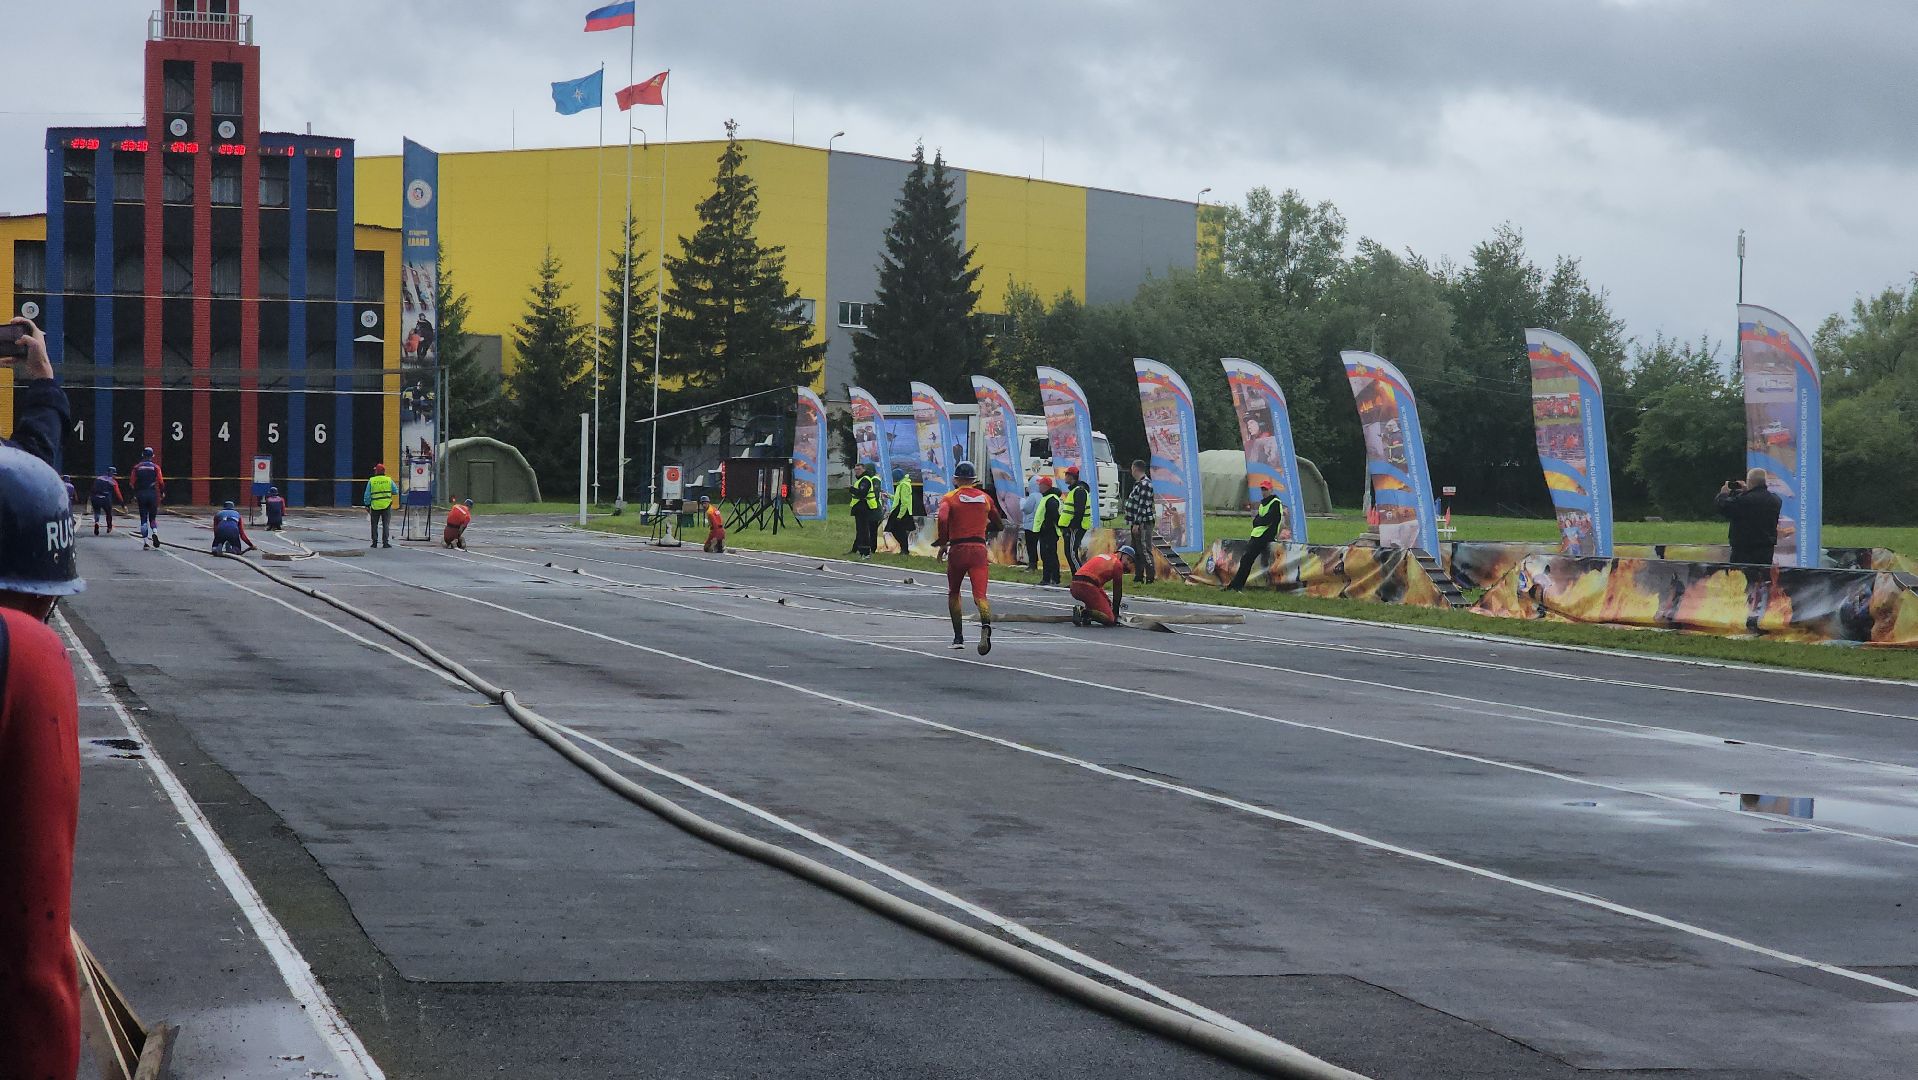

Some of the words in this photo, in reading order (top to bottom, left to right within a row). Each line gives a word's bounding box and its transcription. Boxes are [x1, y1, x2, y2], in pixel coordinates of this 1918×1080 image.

[73, 419, 84, 441] 1
[122, 421, 135, 442] 2
[171, 421, 184, 442] 3
[217, 421, 231, 442] 4
[267, 422, 280, 443] 5
[314, 423, 327, 444] 6
[46, 516, 74, 552] RUS
